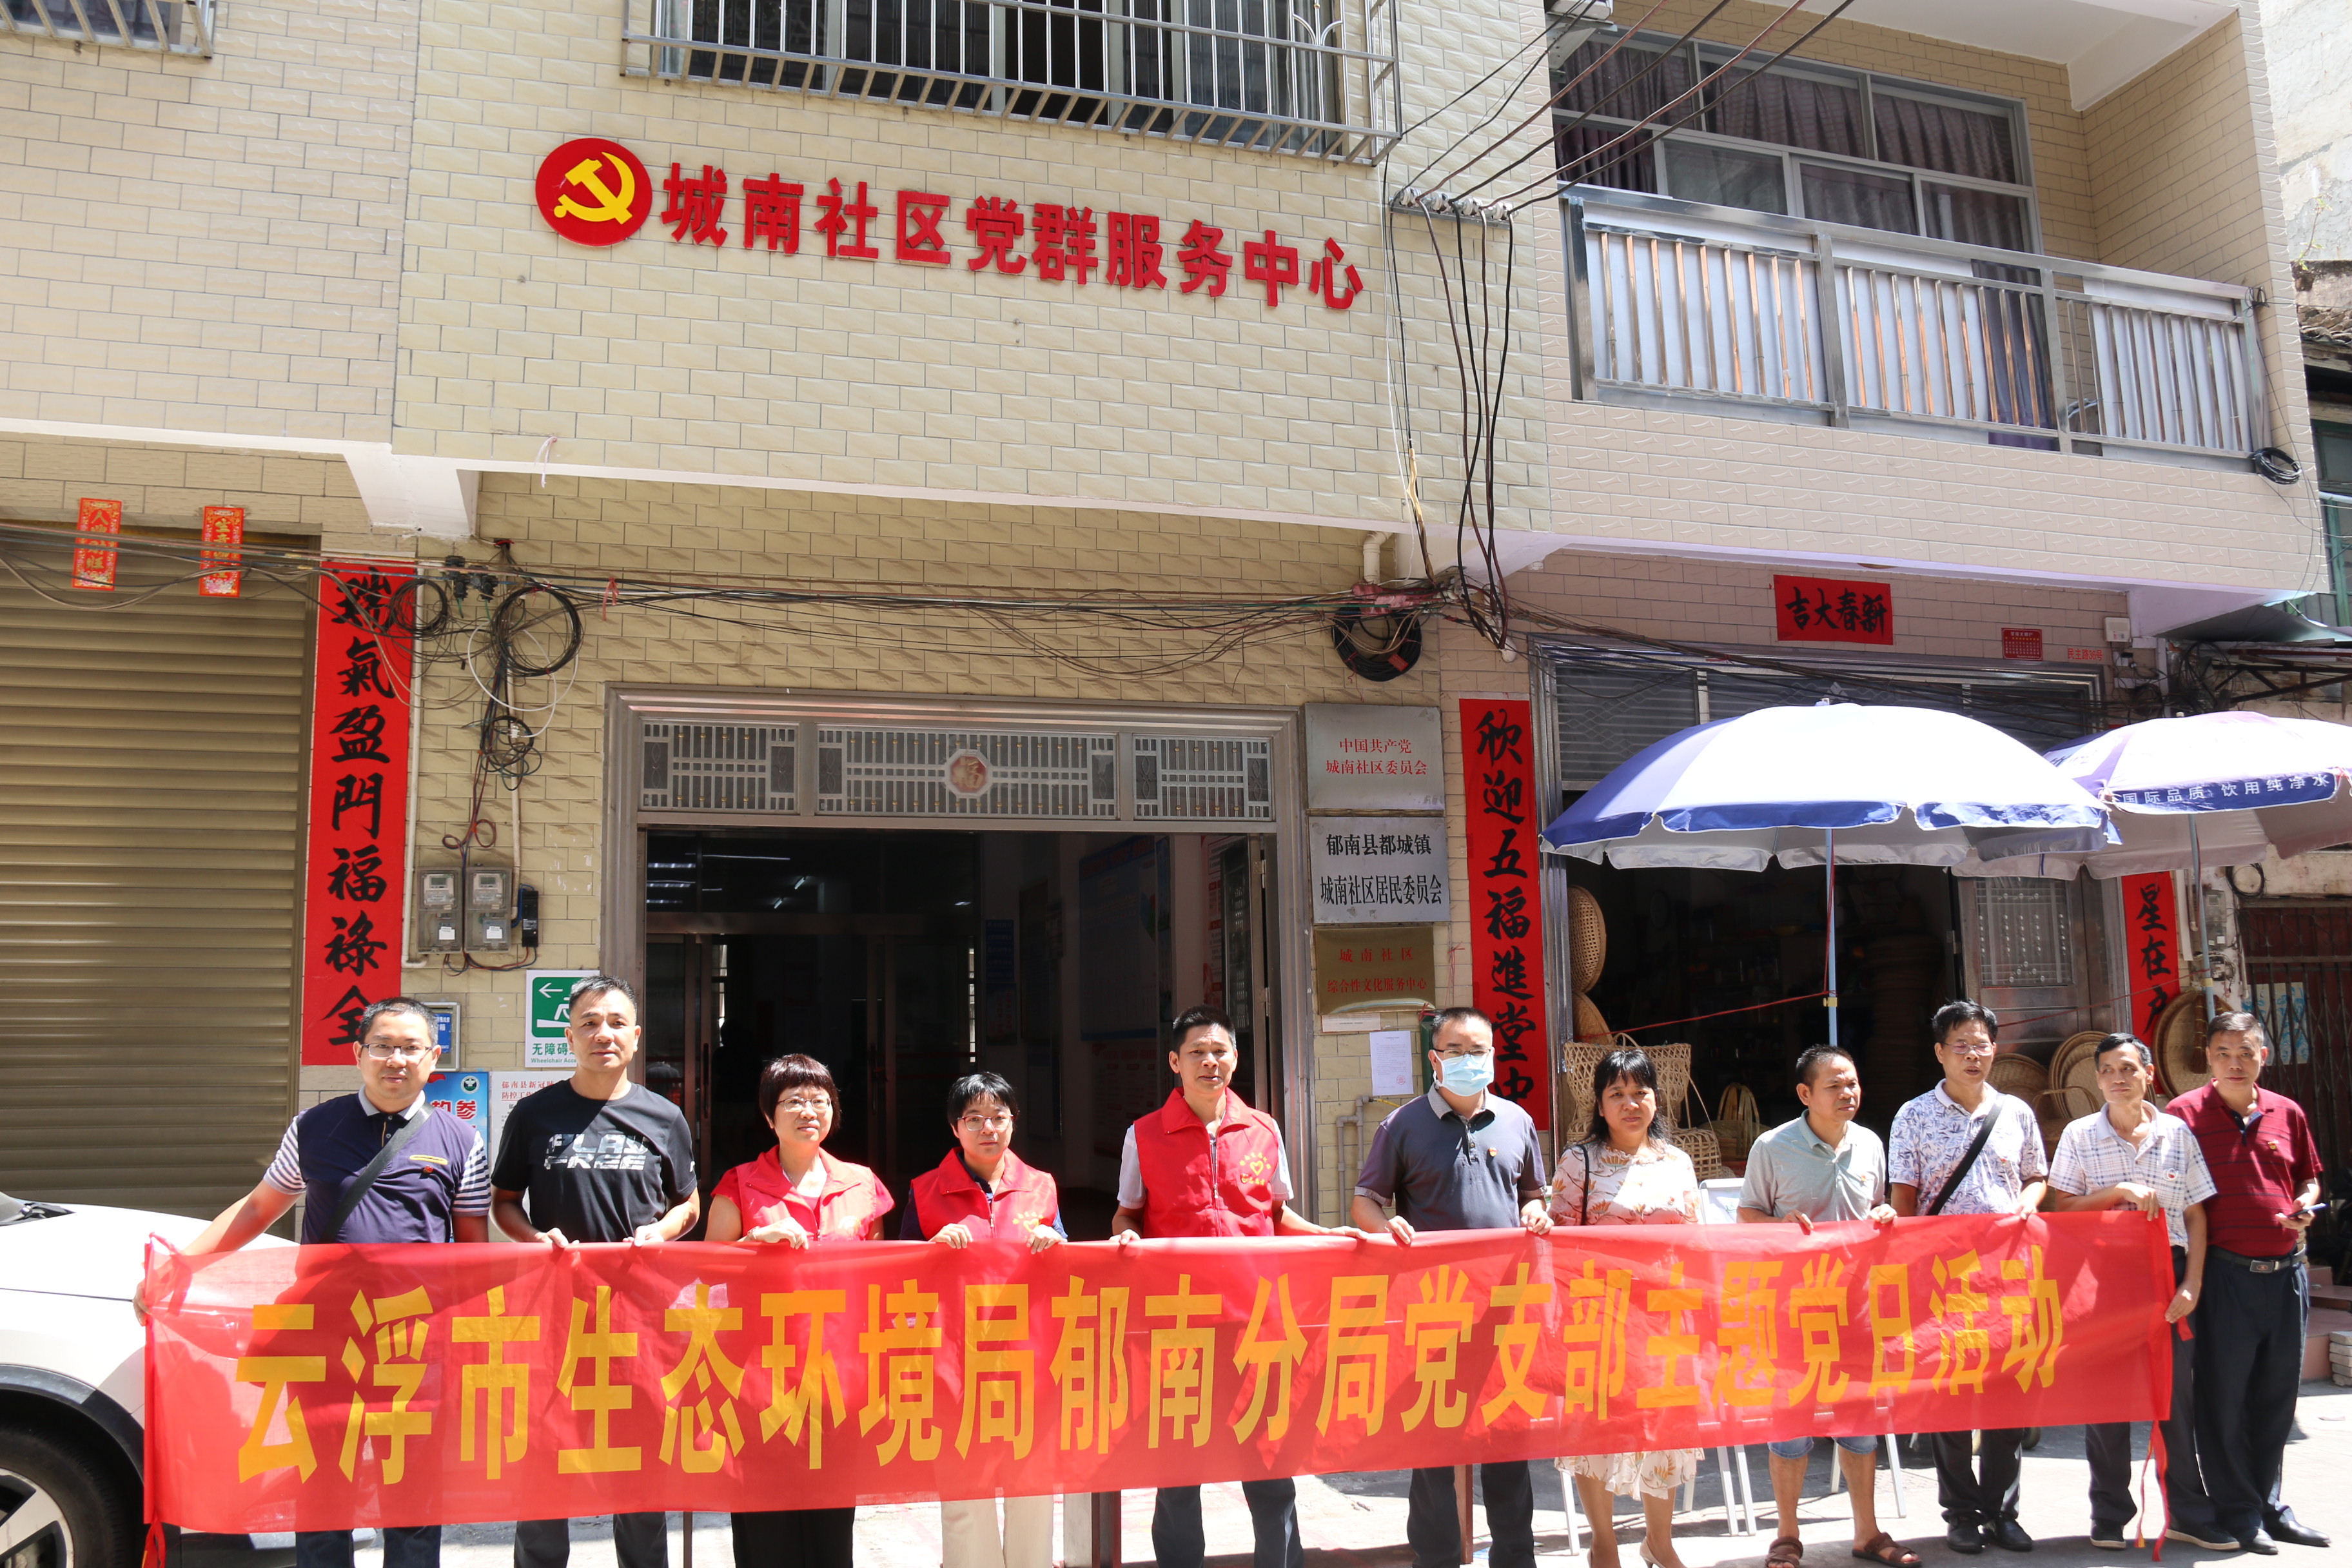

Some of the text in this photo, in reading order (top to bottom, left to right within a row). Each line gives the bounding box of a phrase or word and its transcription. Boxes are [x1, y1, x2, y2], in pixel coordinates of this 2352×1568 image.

[662, 162, 1364, 309] 城南社区党群服务中心
[2068, 647, 2103, 661] 民主路36号
[1340, 738, 1412, 754] 中国共产党
[1326, 760, 1427, 775] 城南社区委员会
[2122, 774, 2329, 804] 国际品质 饮用纯净水
[1326, 834, 1432, 856] 郁南县都城镇
[1320, 874, 1442, 906] 城南社区居民委员会
[1339, 947, 1414, 963] 城南社区
[1327, 977, 1427, 994] 综合性文化服务中心
[532, 1043, 575, 1055] 无障碍
[544, 1154, 646, 1170] FREE
[237, 1244, 2063, 1485] 云浮市生态环境局郁南分局党支部主题党日活动
